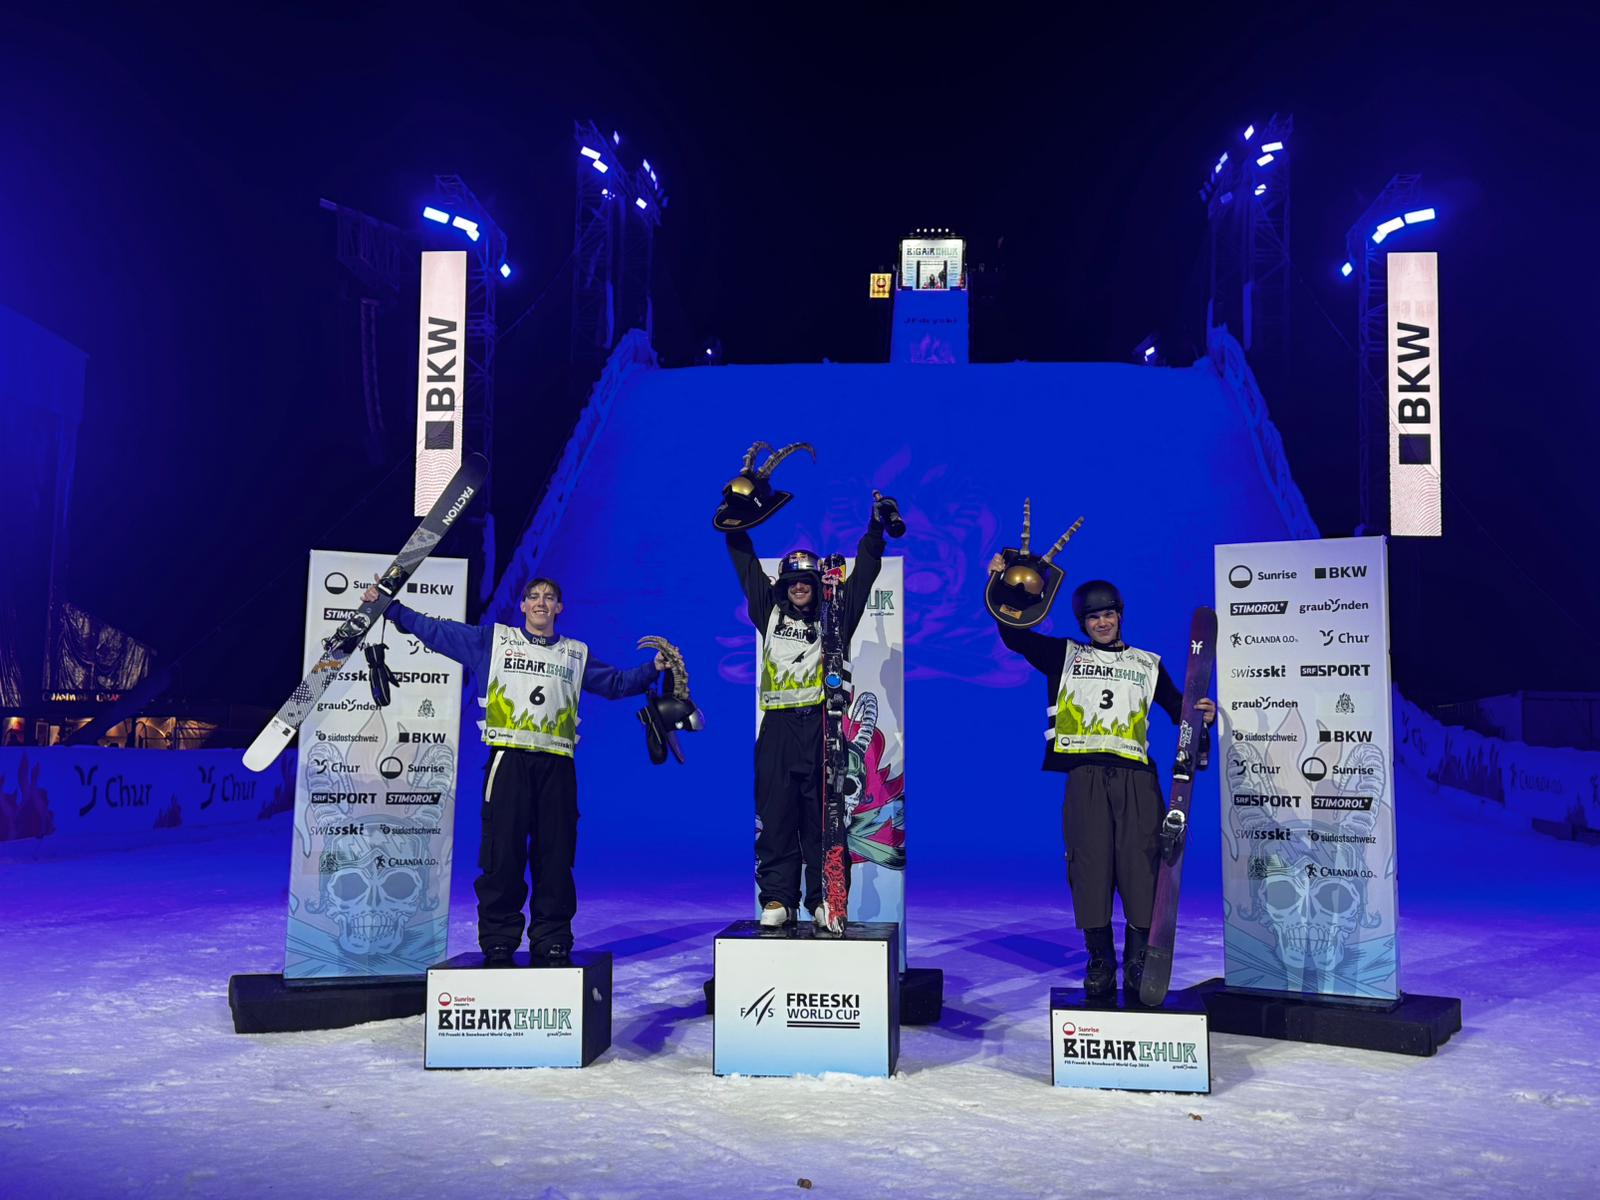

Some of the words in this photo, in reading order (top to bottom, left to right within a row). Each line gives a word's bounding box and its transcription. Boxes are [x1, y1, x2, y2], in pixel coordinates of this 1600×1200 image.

[426, 316, 457, 412] BKW
[1397, 322, 1431, 424] BKW
[442, 486, 474, 526] FACTION
[1257, 570, 1297, 580] Sunrise
[1329, 565, 1367, 578] BKW
[420, 583, 454, 595] BKW
[1338, 632, 1369, 644] Chur
[1301, 666, 1317, 675] SRF
[1317, 664, 1370, 677] SPORT
[529, 685, 546, 706] 6
[1099, 689, 1114, 710] 3
[327, 733, 378, 743] südostschweiz
[412, 732, 446, 743] BKW
[1244, 732, 1298, 742] südostschweiz
[1334, 730, 1373, 743] BKW
[331, 762, 360, 773] Chur
[408, 763, 445, 773] Sunrise
[1251, 763, 1281, 774] Chur
[1332, 765, 1374, 775] Sunrise
[105, 775, 152, 808] Chur
[221, 773, 257, 802] Chur
[328, 793, 377, 804] SPORT
[1251, 795, 1301, 808] SPORT
[392, 826, 442, 835] südostschweiz
[1320, 834, 1376, 844] südostschweiz
[786, 993, 860, 1008] FREESKI
[514, 1008, 572, 1030] CHUR
[787, 1008, 833, 1020] WORLD
[835, 1009, 860, 1020] CUP
[1138, 1041, 1198, 1063] CHUR
